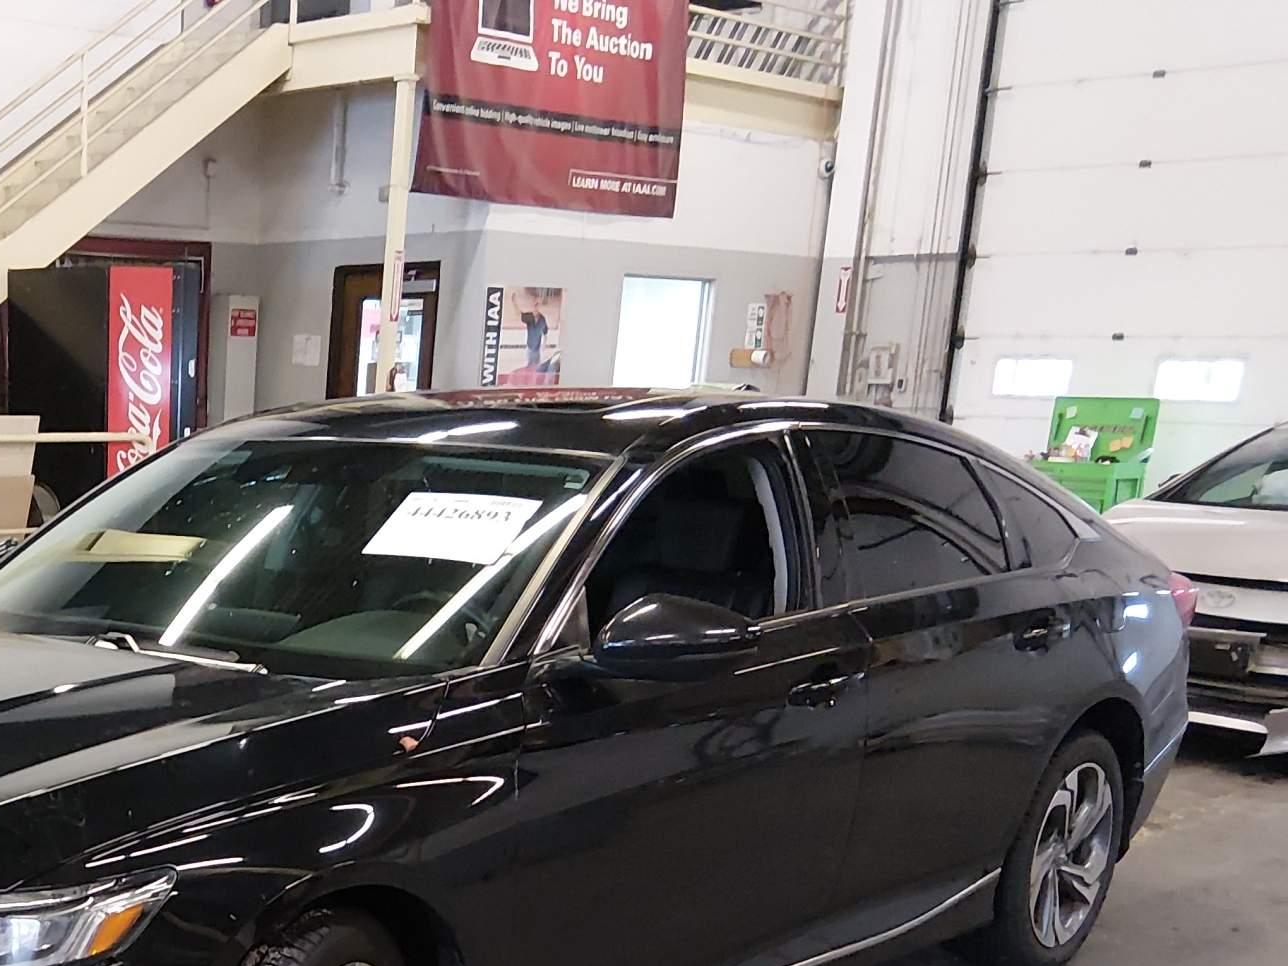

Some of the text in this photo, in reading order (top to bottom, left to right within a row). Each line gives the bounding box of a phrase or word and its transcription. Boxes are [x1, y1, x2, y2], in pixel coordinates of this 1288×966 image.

[582, 0, 629, 29] Bring
[552, 18, 653, 60] The Auction
[548, 51, 605, 83] To You
[572, 176, 599, 190] LEARN
[620, 181, 633, 193] AT
[481, 291, 502, 384] WITH IAA
[408, 506, 513, 522] 44426893
